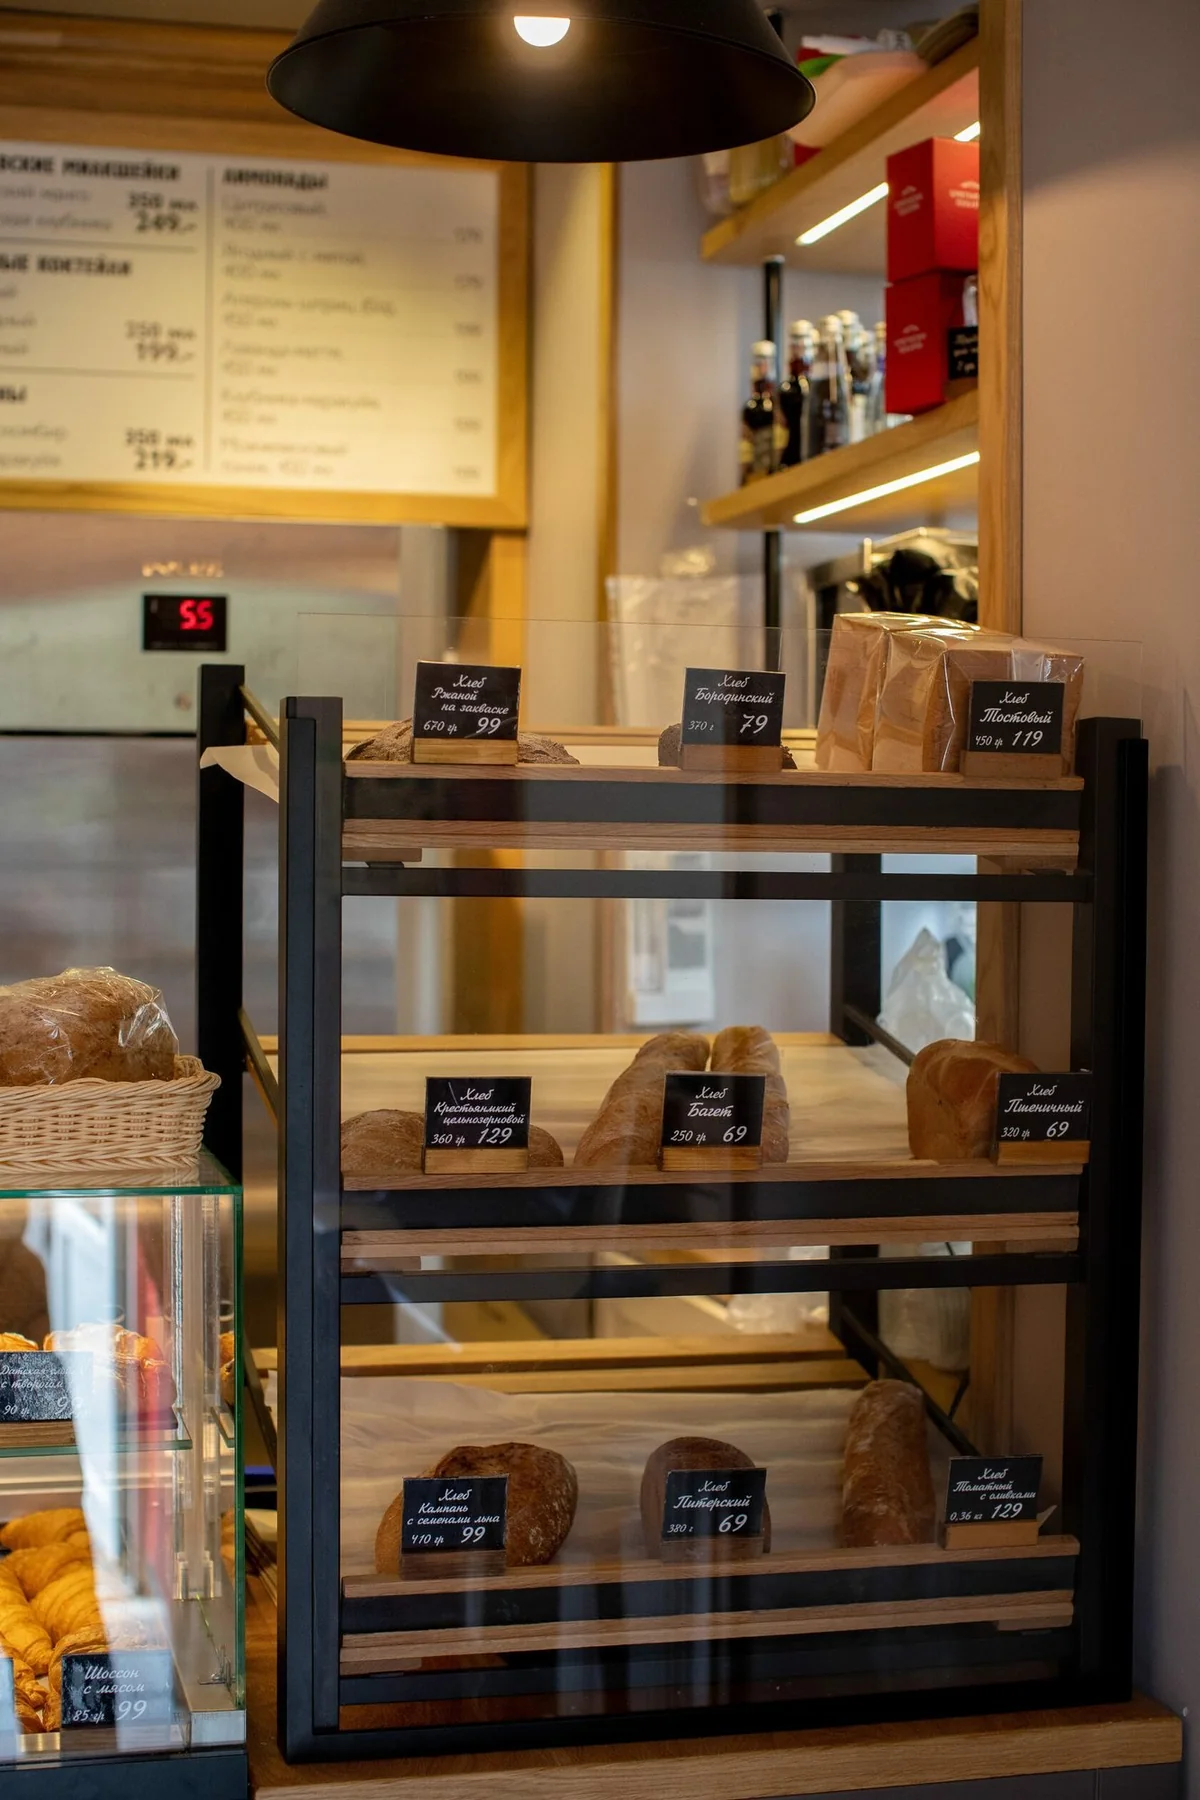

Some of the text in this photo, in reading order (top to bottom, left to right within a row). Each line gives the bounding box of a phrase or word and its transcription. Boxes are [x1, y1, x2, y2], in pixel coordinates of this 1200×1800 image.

[453, 674, 487, 688] Хлеб
[717, 674, 750, 688] Хлеб
[431, 687, 479, 700] Ржаной
[695, 687, 775, 705] Бородинский
[999, 691, 1030, 704] Хлеб
[460, 703, 509, 714] закваске
[980, 707, 1054, 724] Тостовый
[424, 717, 501, 735] 670 гр 99
[688, 720, 708, 731] 370
[740, 714, 768, 734] 79
[975, 730, 1043, 749] 450 гр 119
[460, 1088, 494, 1101] Хлеб
[695, 1086, 729, 1099] Хлеб
[1026, 1083, 1058, 1096] Хлеб
[687, 1102, 734, 1117] Багет
[1004, 1098, 1084, 1113] Пшеничный
[443, 1114, 526, 1127] цельнозерновой
[431, 1127, 513, 1147] 360 гр 129
[670, 1125, 748, 1145] 250 гр 69
[1000, 1121, 1070, 1140] 320 гр 69
[1, 1379, 63, 1391] с творогом
[4, 1405, 18, 1415] 90
[977, 1468, 1009, 1480] Хлеб
[697, 1480, 731, 1492] Хлеб
[952, 1480, 1014, 1492] Томатный
[438, 1488, 473, 1501] Хлеб
[989, 1491, 1037, 1500] оливками
[418, 1502, 469, 1514] Кампань
[673, 1495, 752, 1512] Питерский
[949, 1511, 972, 1522] 0,36
[991, 1502, 1023, 1519] 129
[417, 1516, 471, 1525] семенами
[474, 1515, 500, 1523] льна
[667, 1523, 687, 1533] 380
[718, 1513, 748, 1533] 69
[411, 1534, 432, 1545] 410
[460, 1526, 486, 1543] 99
[84, 1666, 139, 1680] Шоссон
[83, 1683, 145, 1694] с мясом
[73, 1710, 90, 1721] 85
[117, 1700, 147, 1720] 99
